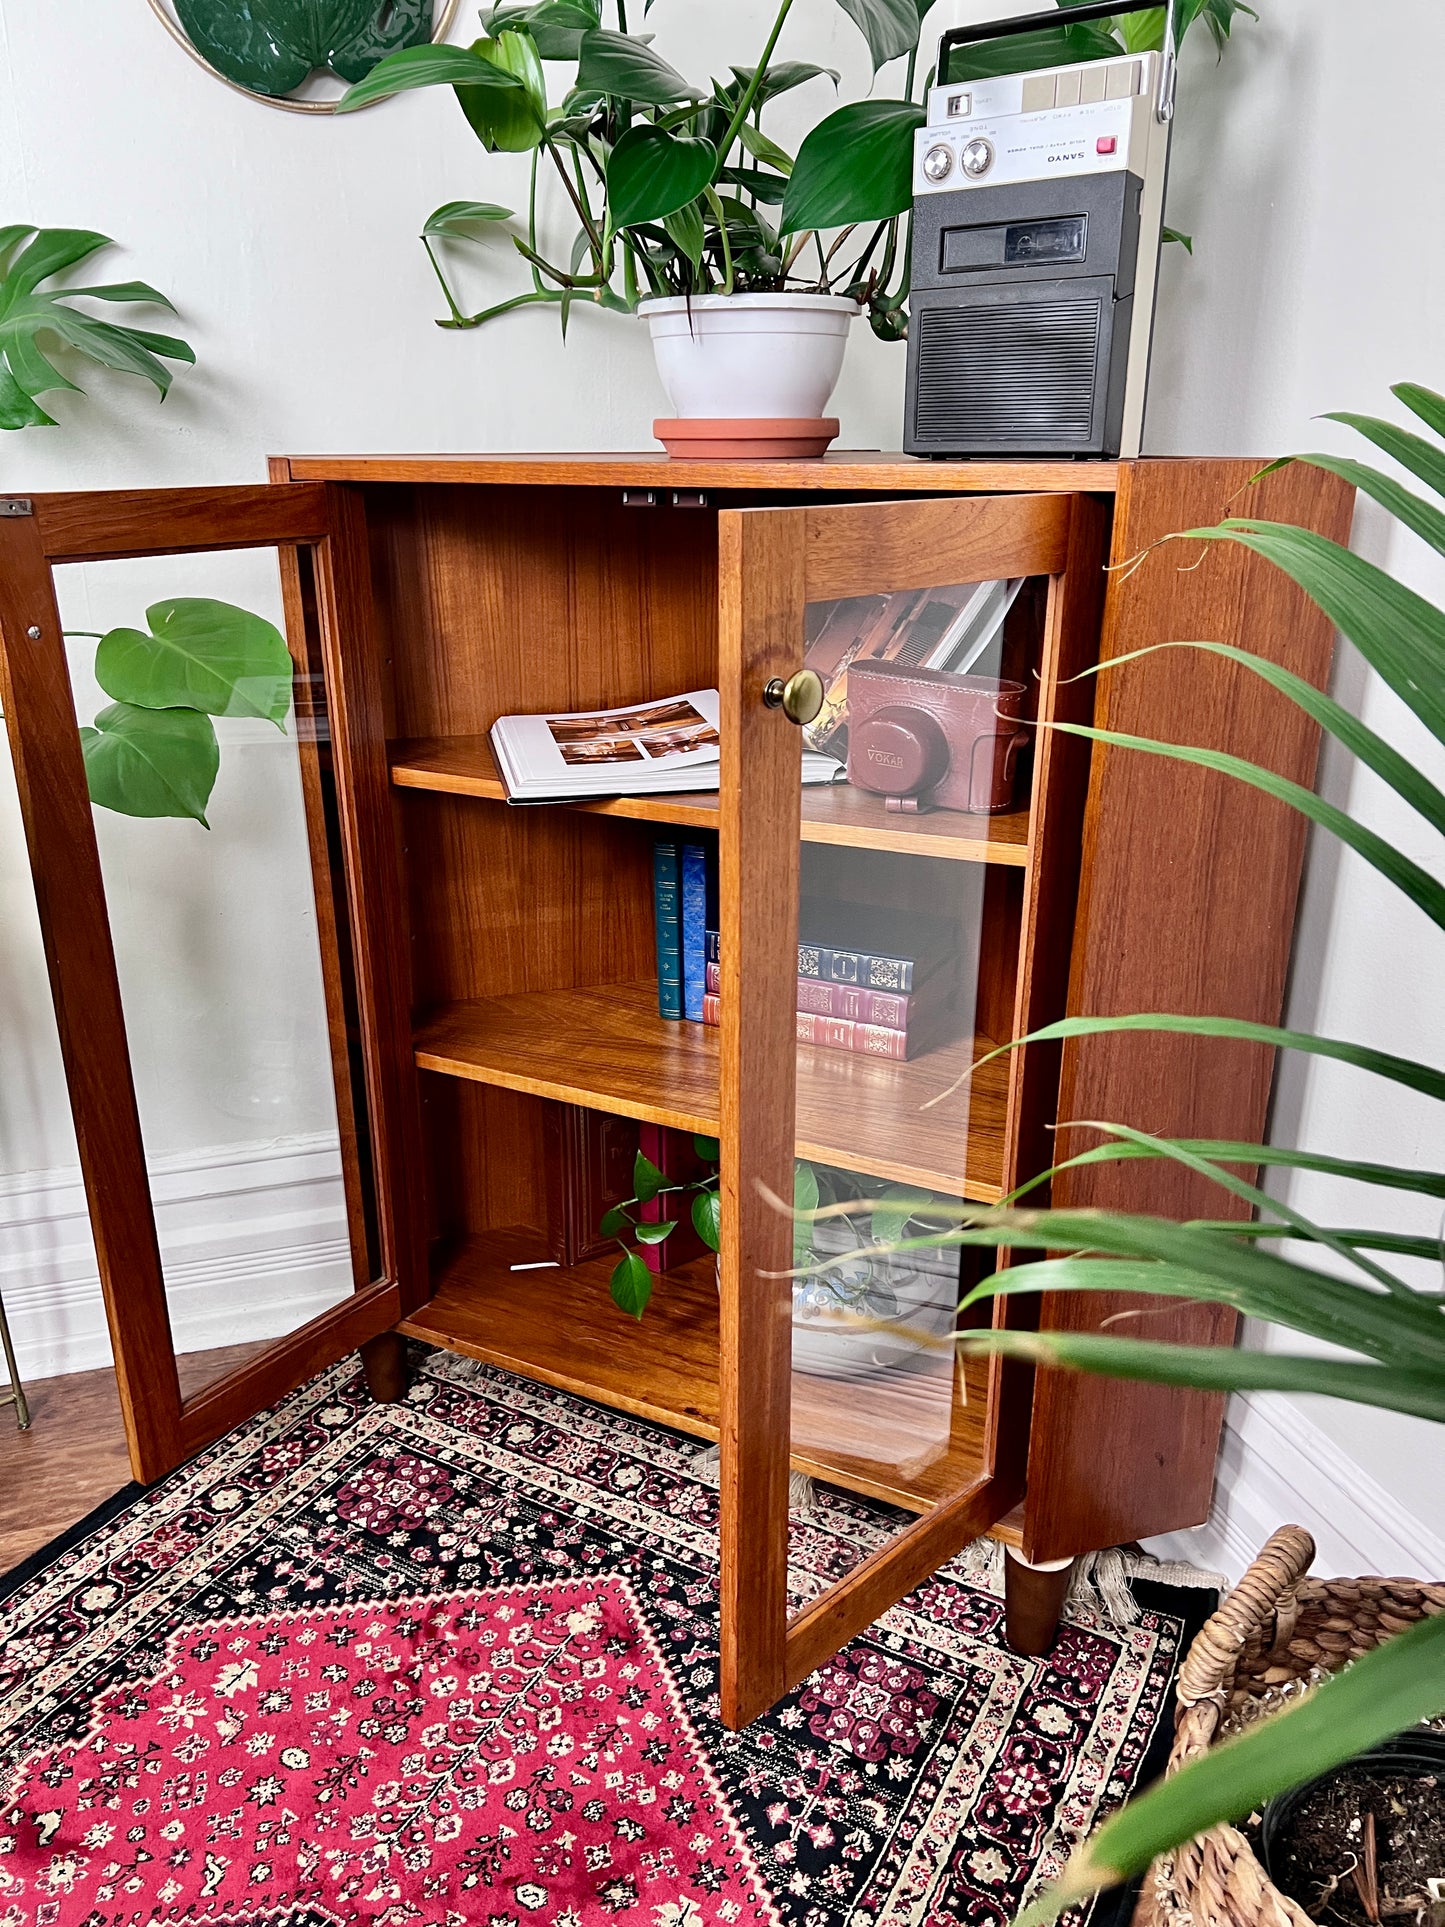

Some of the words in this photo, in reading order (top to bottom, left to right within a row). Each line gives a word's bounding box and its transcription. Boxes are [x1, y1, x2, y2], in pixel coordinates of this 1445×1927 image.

[969, 124, 988, 132] TONE
[929, 130, 951, 138] VOLUME
[1047, 152, 1085, 162] SANYO
[868, 749, 904, 767] VOKAR
